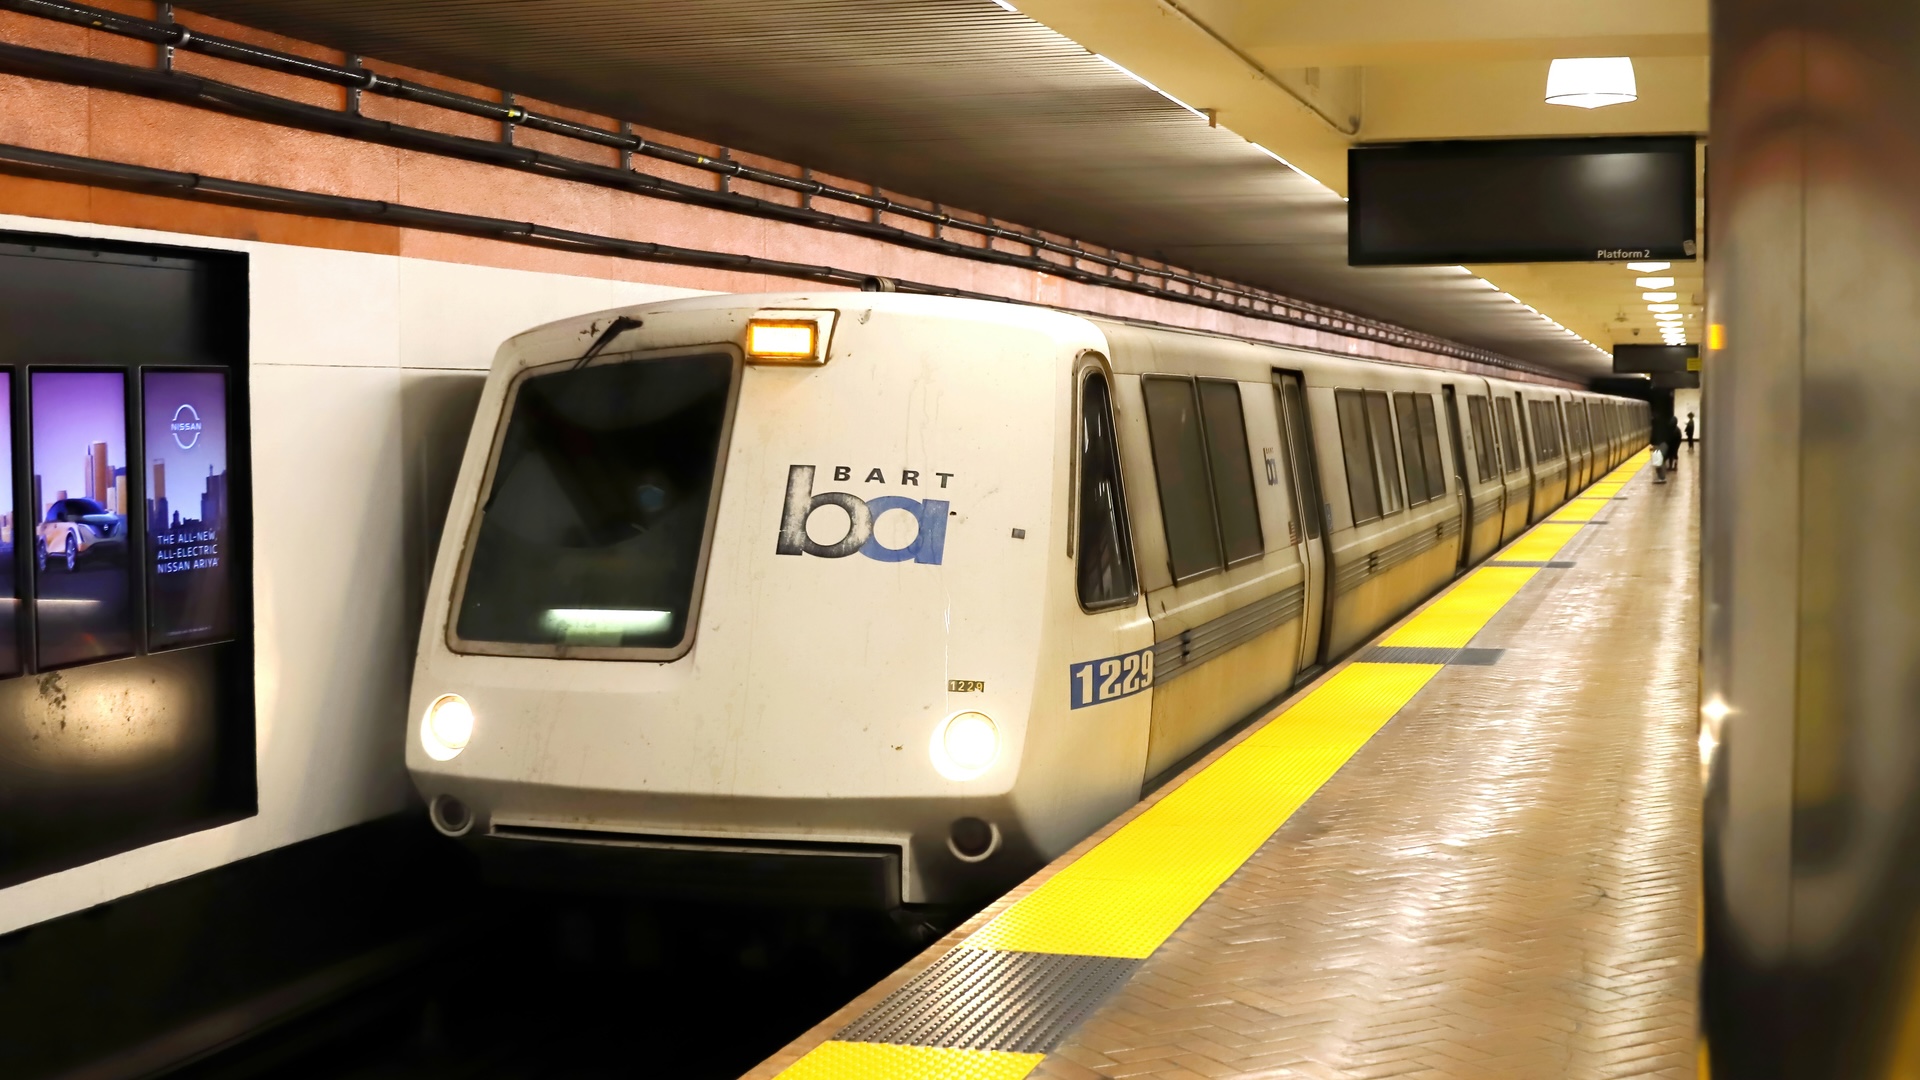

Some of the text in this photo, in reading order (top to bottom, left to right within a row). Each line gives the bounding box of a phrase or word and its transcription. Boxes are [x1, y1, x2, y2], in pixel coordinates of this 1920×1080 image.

[1597, 249, 1651, 259] Platform 2
[171, 422, 202, 431] NISSAN
[833, 465, 954, 489] BART
[157, 533, 175, 545] THE
[157, 543, 218, 560] ALL-ELECTRIC
[157, 557, 219, 574] NISSAN ARIYA
[1076, 650, 1154, 705] 1229
[950, 680, 983, 692] 1229
